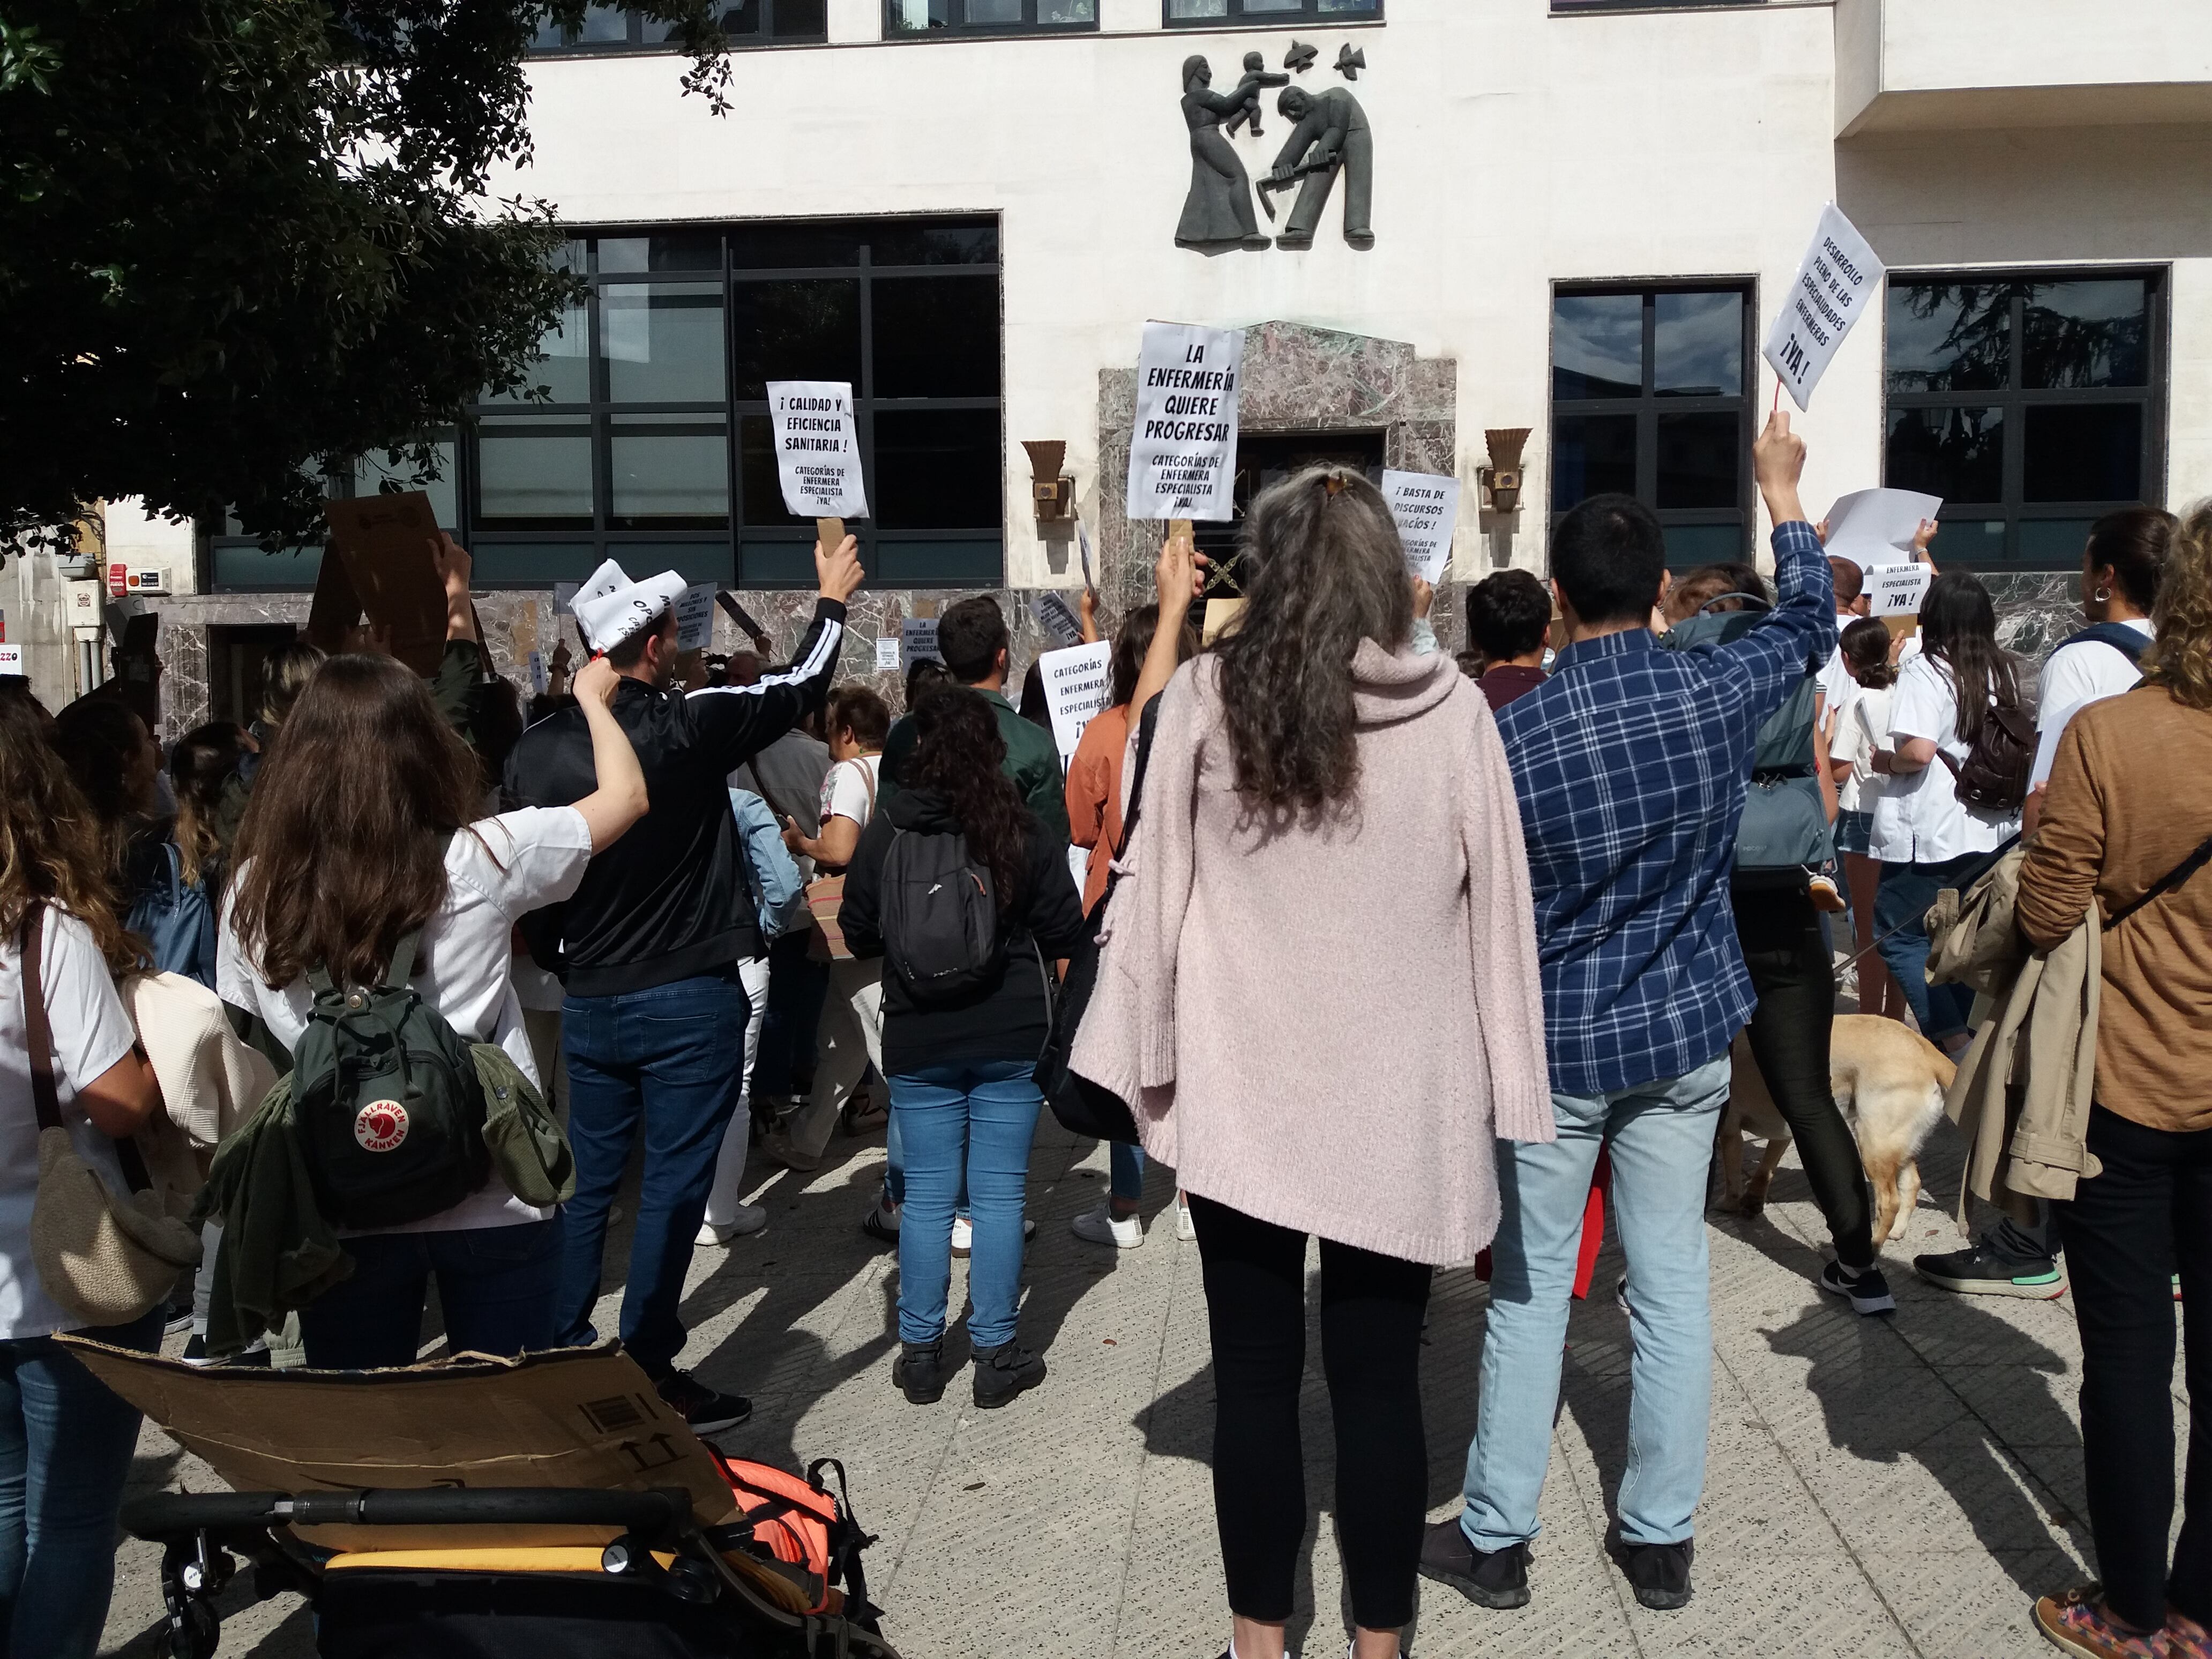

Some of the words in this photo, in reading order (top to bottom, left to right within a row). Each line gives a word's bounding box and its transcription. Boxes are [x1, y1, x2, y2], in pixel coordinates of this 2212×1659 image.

[1823, 236, 1863, 286] DESARROLLO
[1814, 256, 1829, 282] PLENO
[1828, 279, 1840, 293] DE
[1837, 287, 1852, 307] LAS
[1803, 272, 1845, 332] ESPECIALIDADES
[1796, 298, 1829, 346] ENFERMERAS
[1186, 344, 1205, 363] LA
[1147, 365, 1235, 391] ENFERMERÍA
[789, 398, 831, 411] CALIDAD
[835, 399, 842, 411] Y
[1165, 395, 1219, 416] QUIERE
[787, 417, 841, 431] EFICIENCIA
[1145, 420, 1230, 442] PROGRESAR
[785, 437, 839, 452] SANITARIA
[1152, 452, 1208, 467] CATEGORÍAS
[1209, 456, 1220, 468] DE
[795, 465, 835, 476] CATEGORÍAS
[837, 468, 845, 476] DE
[1161, 469, 1209, 481] ENFERMERA
[803, 476, 840, 486] ENFERMERA
[801, 486, 842, 496] ESPECIALISTA
[1155, 483, 1212, 495] ESPECIALISTA
[1403, 488, 1431, 498] BASTA
[1433, 490, 1446, 499] DE
[817, 497, 831, 505] ¡YA!
[1394, 503, 1444, 515] DISCURSOS
[1398, 517, 1430, 529] VACÍOS
[1886, 565, 1919, 574] ENFERMERA
[1882, 579, 1921, 588] ESPECIALISTA
[906, 627, 938, 636] ENFERMERÍ
[1054, 659, 1102, 678] CATEGORÍAS
[1060, 679, 1104, 696] ENFERMERA
